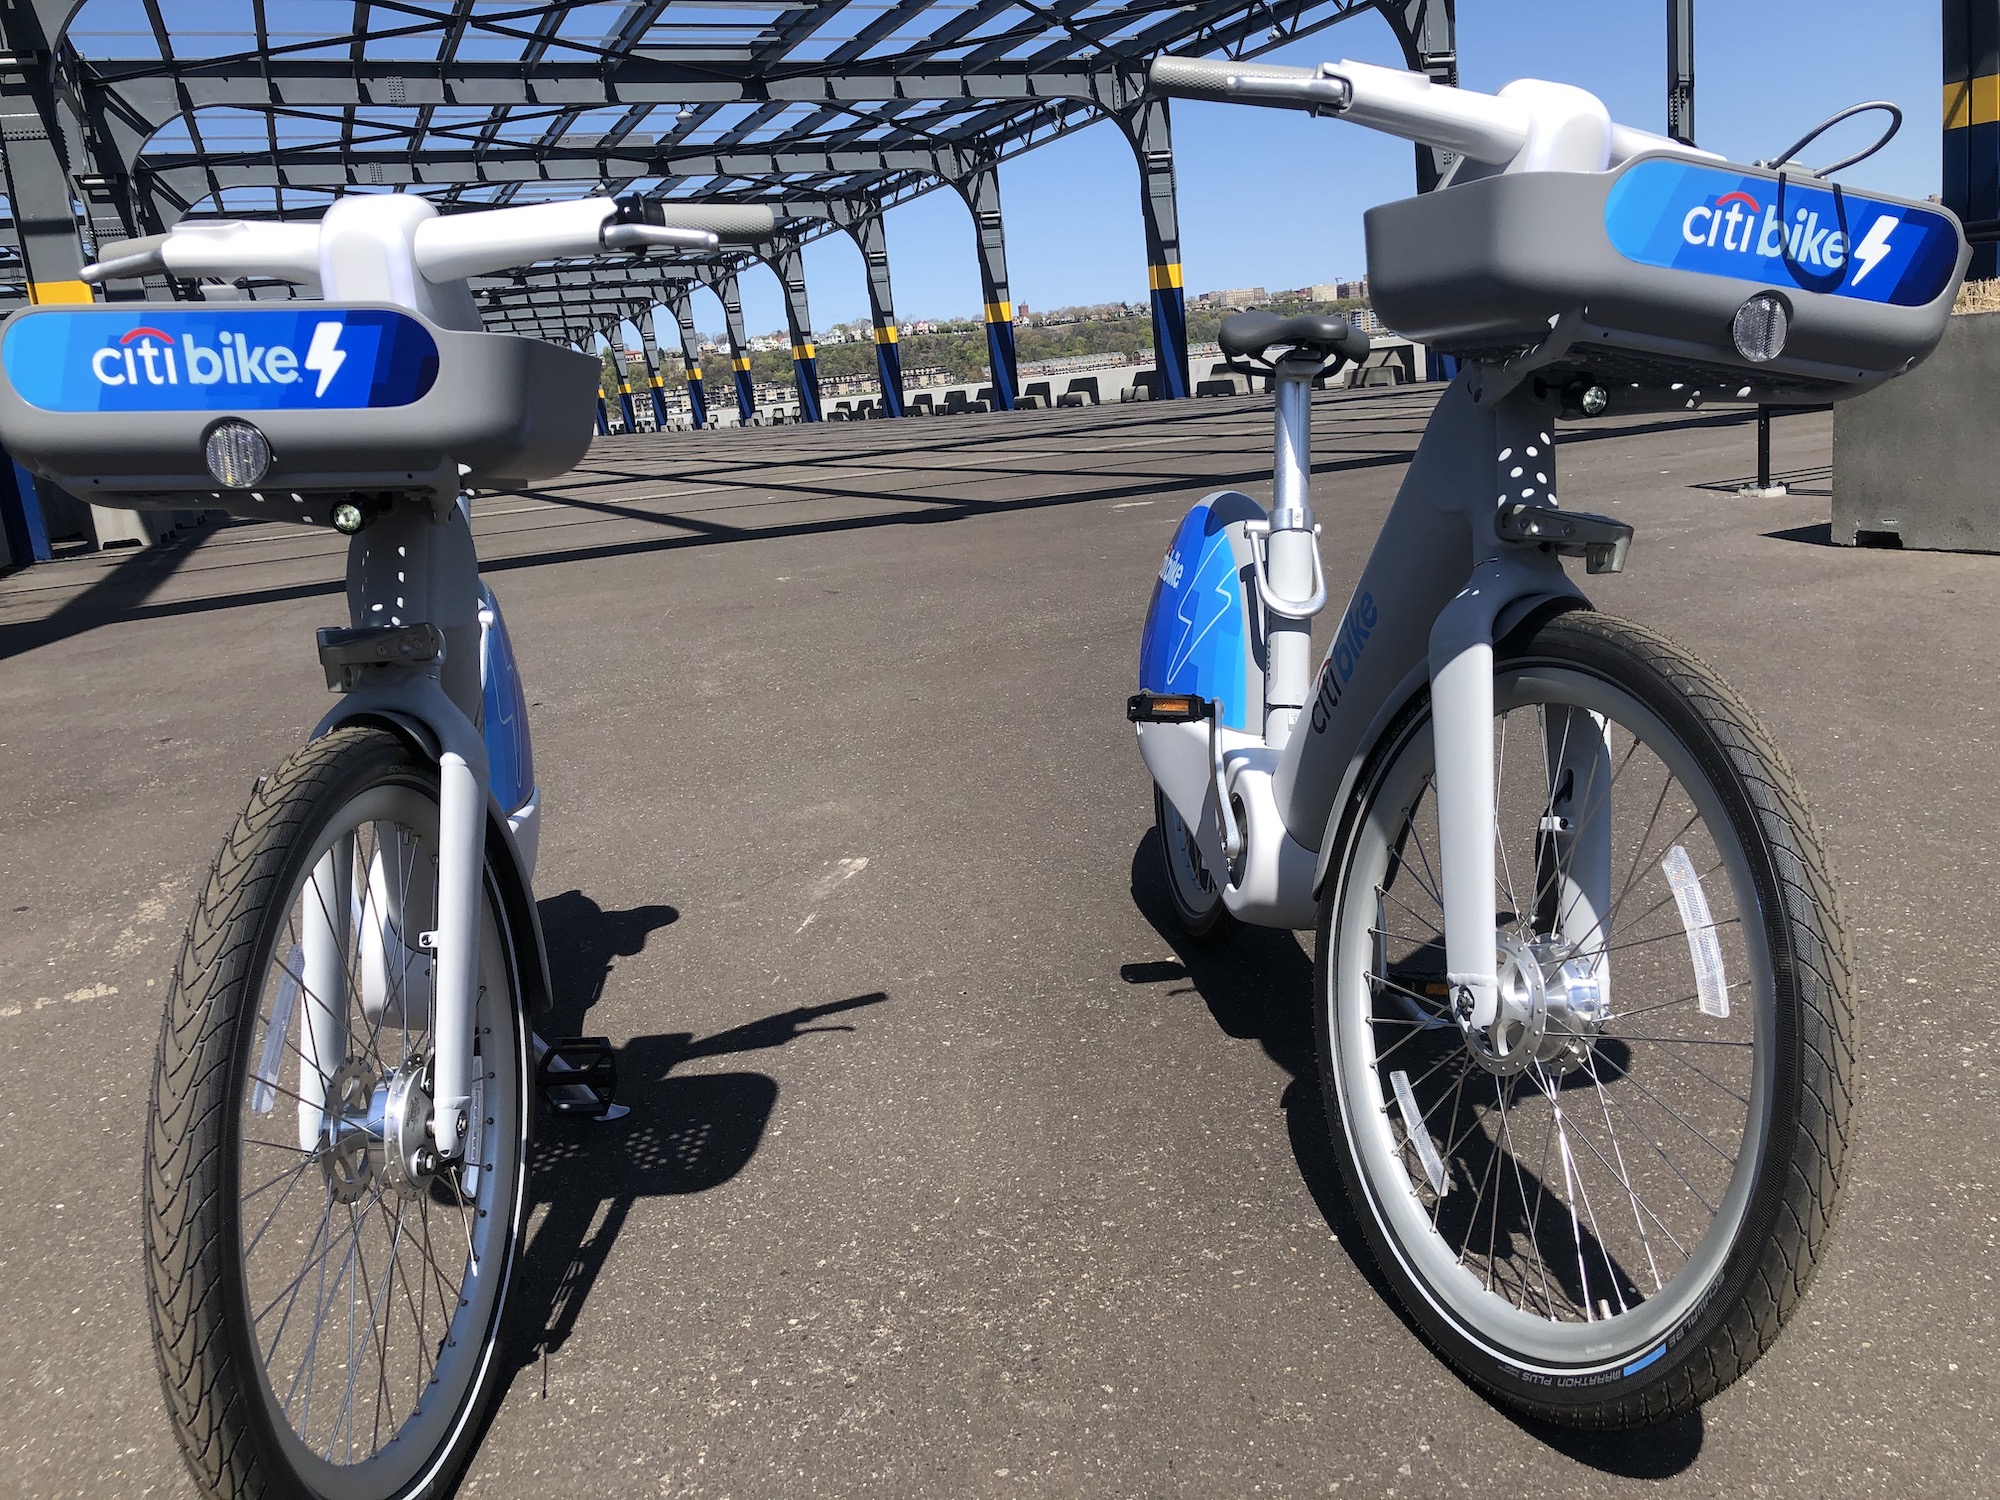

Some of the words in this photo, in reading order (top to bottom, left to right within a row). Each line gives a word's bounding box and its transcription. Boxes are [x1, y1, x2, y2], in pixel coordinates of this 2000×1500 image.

[1682, 191, 1760, 252] citi
[1756, 204, 1851, 269] bike
[91, 326, 177, 386] citi
[182, 331, 300, 385] bike
[1311, 659, 1342, 734] citi
[1335, 592, 1377, 684] bike
[1521, 1371, 1553, 1386] PLUS
[1557, 1369, 1621, 1388] MARATHON
